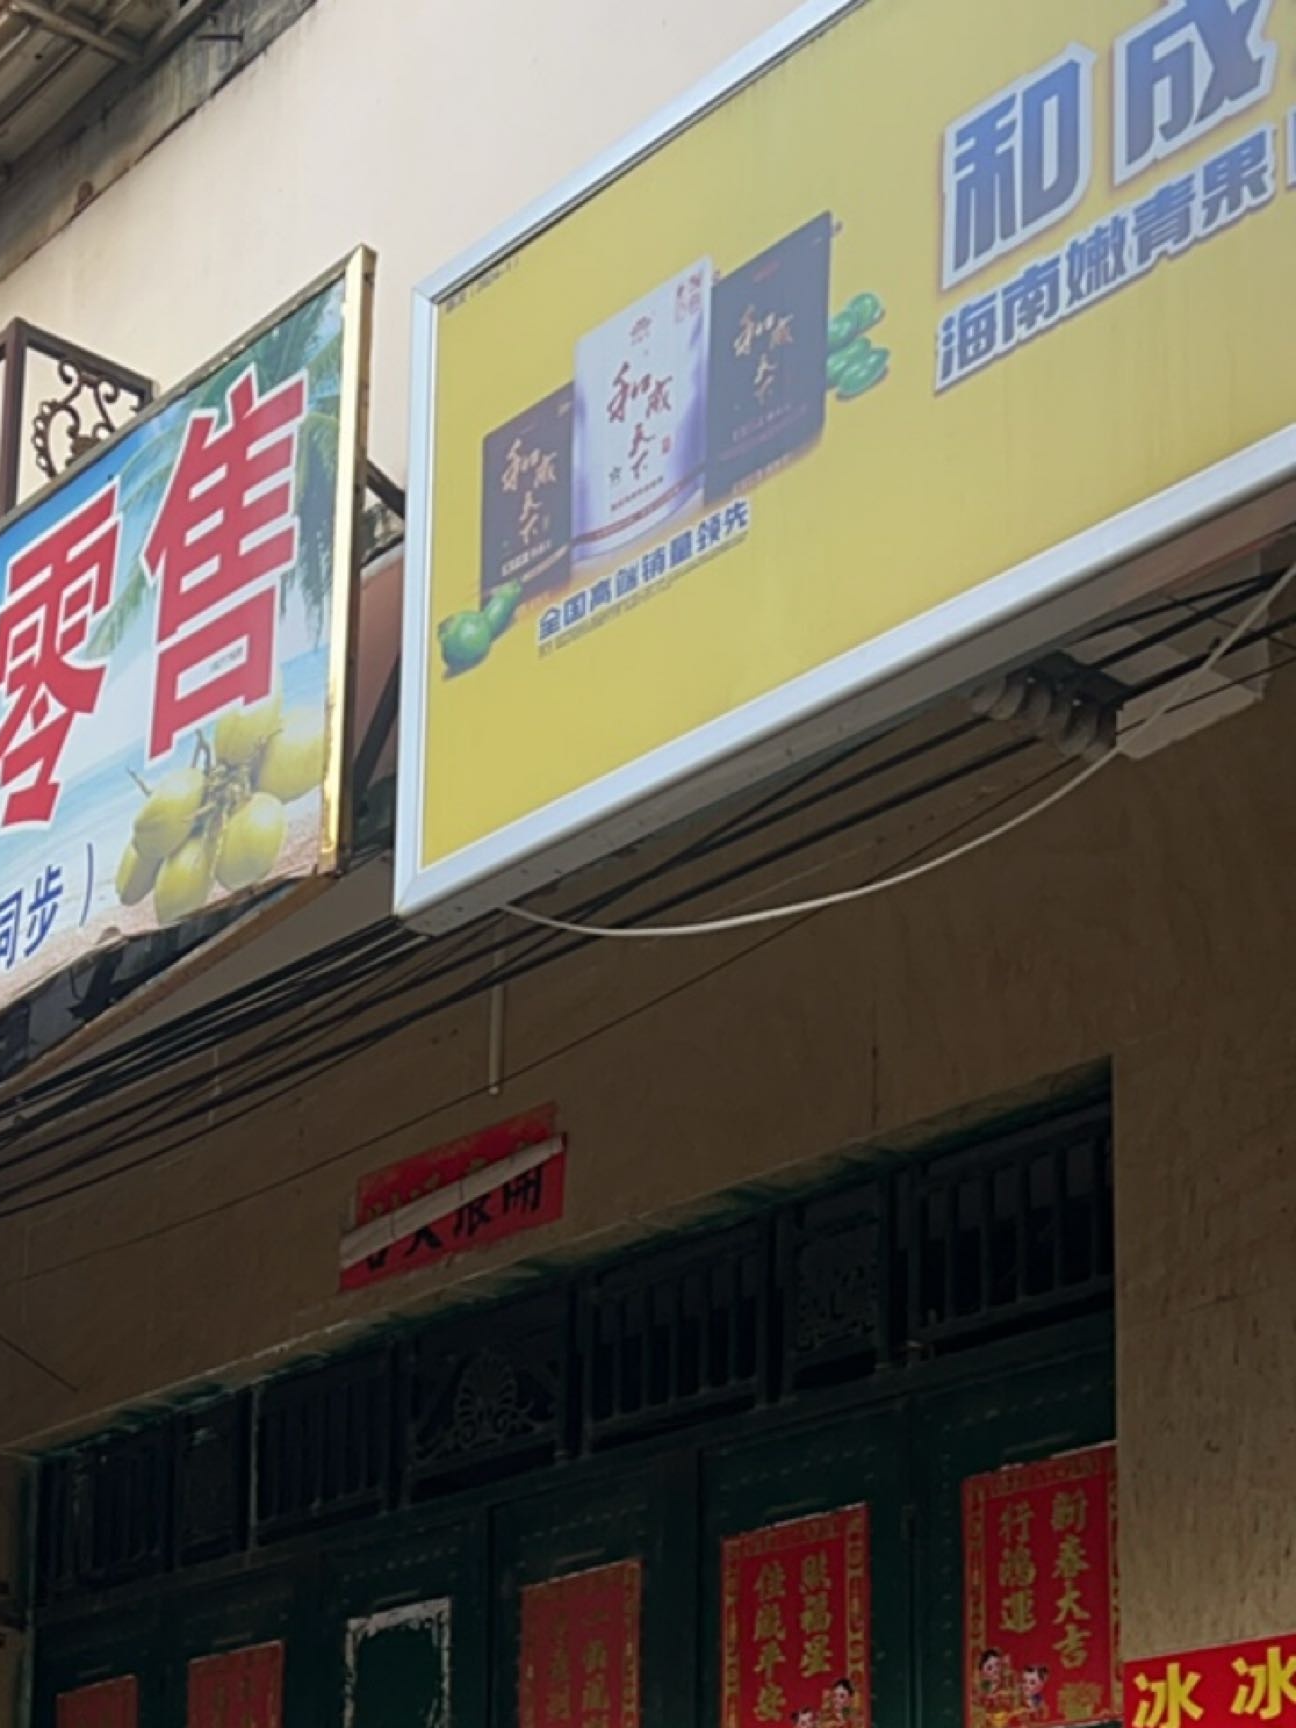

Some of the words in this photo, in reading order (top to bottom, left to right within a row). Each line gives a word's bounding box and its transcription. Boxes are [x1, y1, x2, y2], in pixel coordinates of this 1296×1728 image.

[939, 127, 1272, 386] 海南嫩青果
